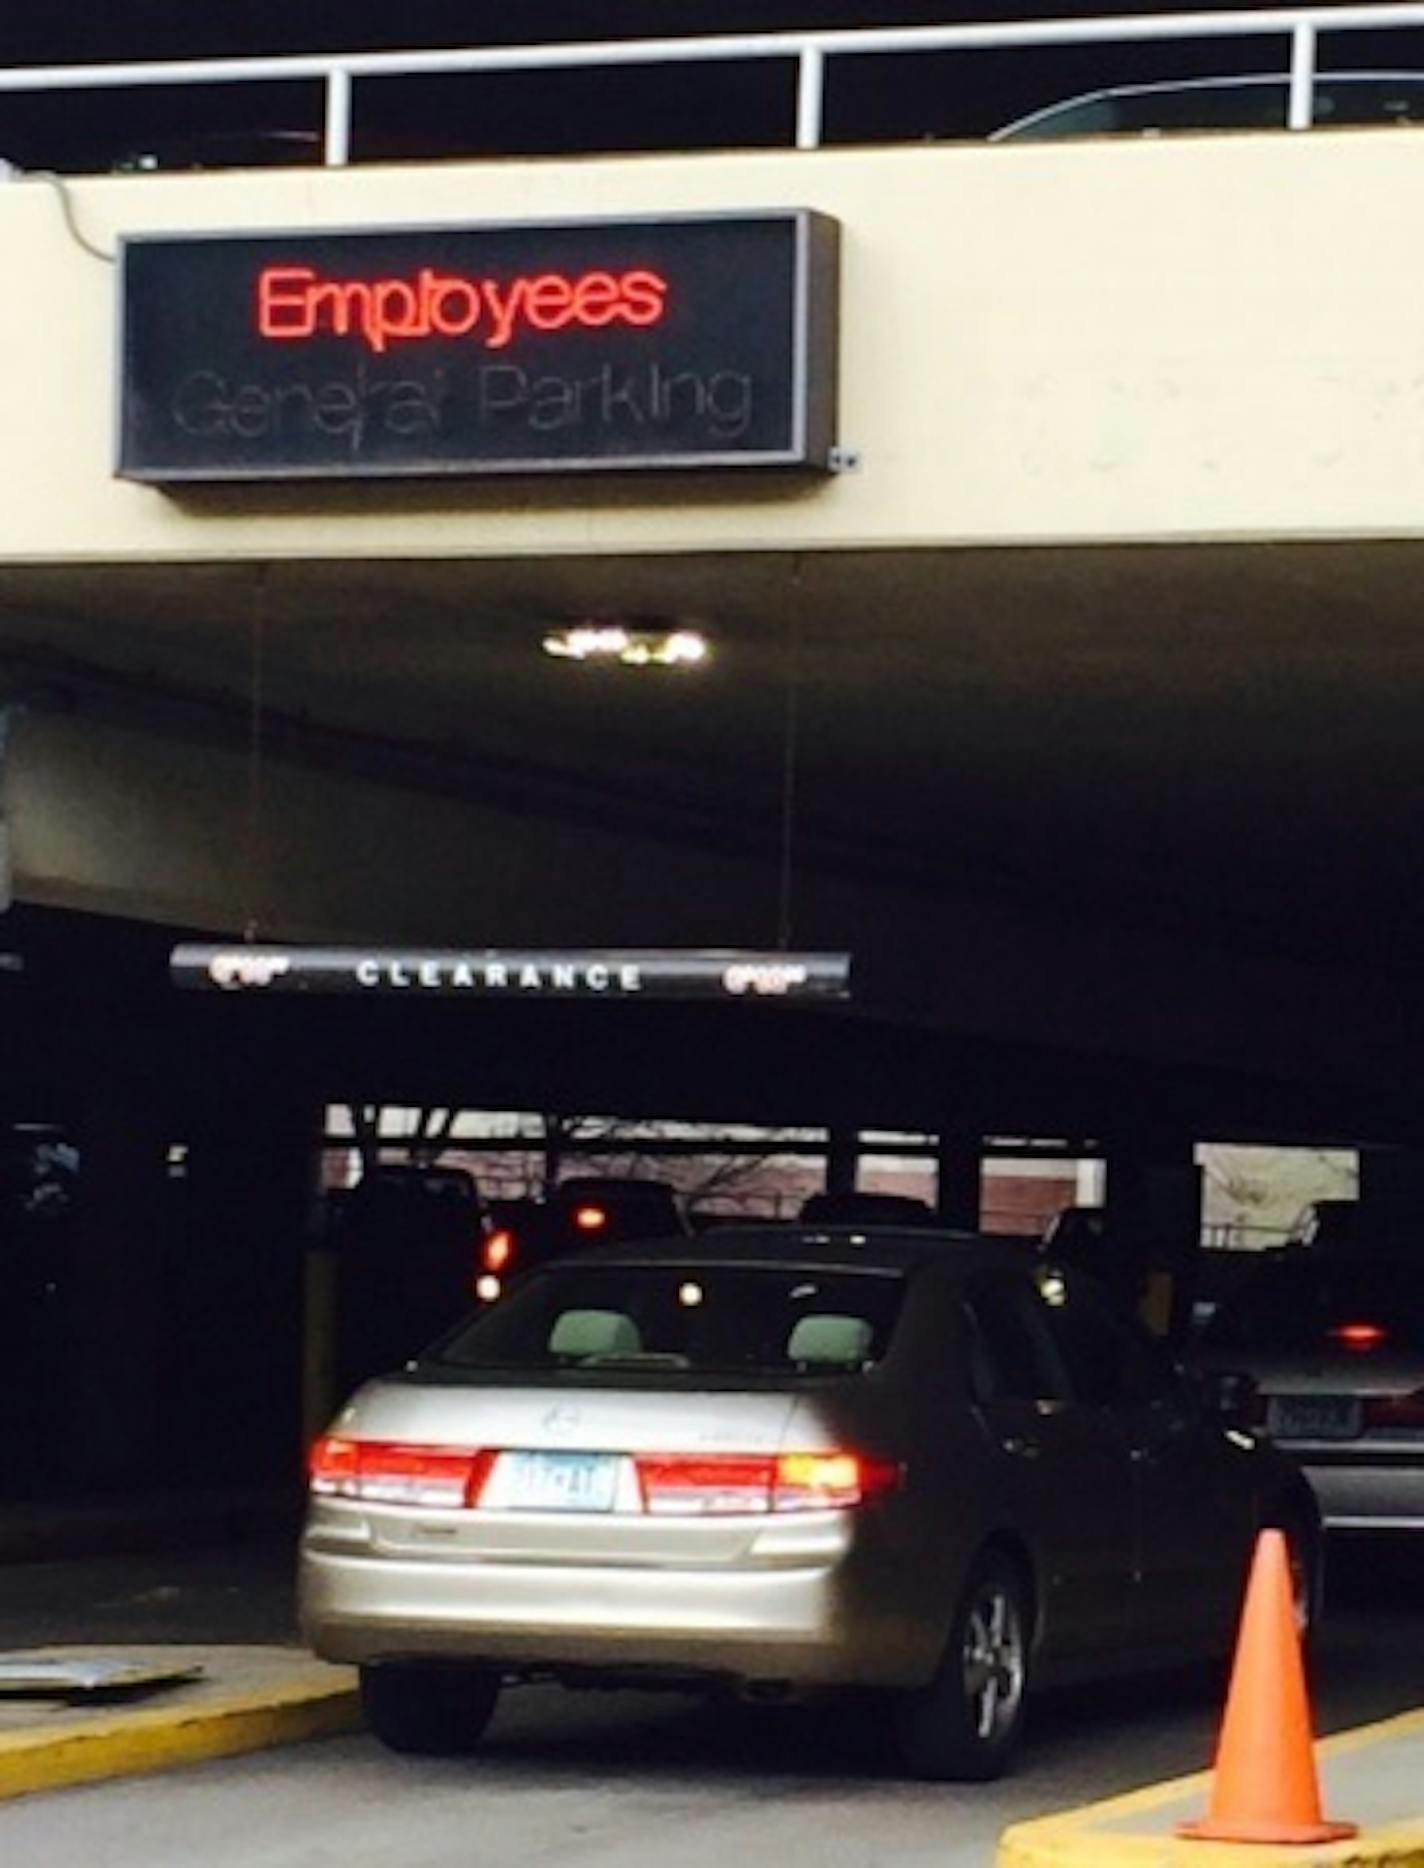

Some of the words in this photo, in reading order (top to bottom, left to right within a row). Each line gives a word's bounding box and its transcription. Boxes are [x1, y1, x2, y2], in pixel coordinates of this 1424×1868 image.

[258, 267, 668, 351] Employees
[476, 362, 755, 436] Parking
[355, 960, 644, 991] CLEARANCE
